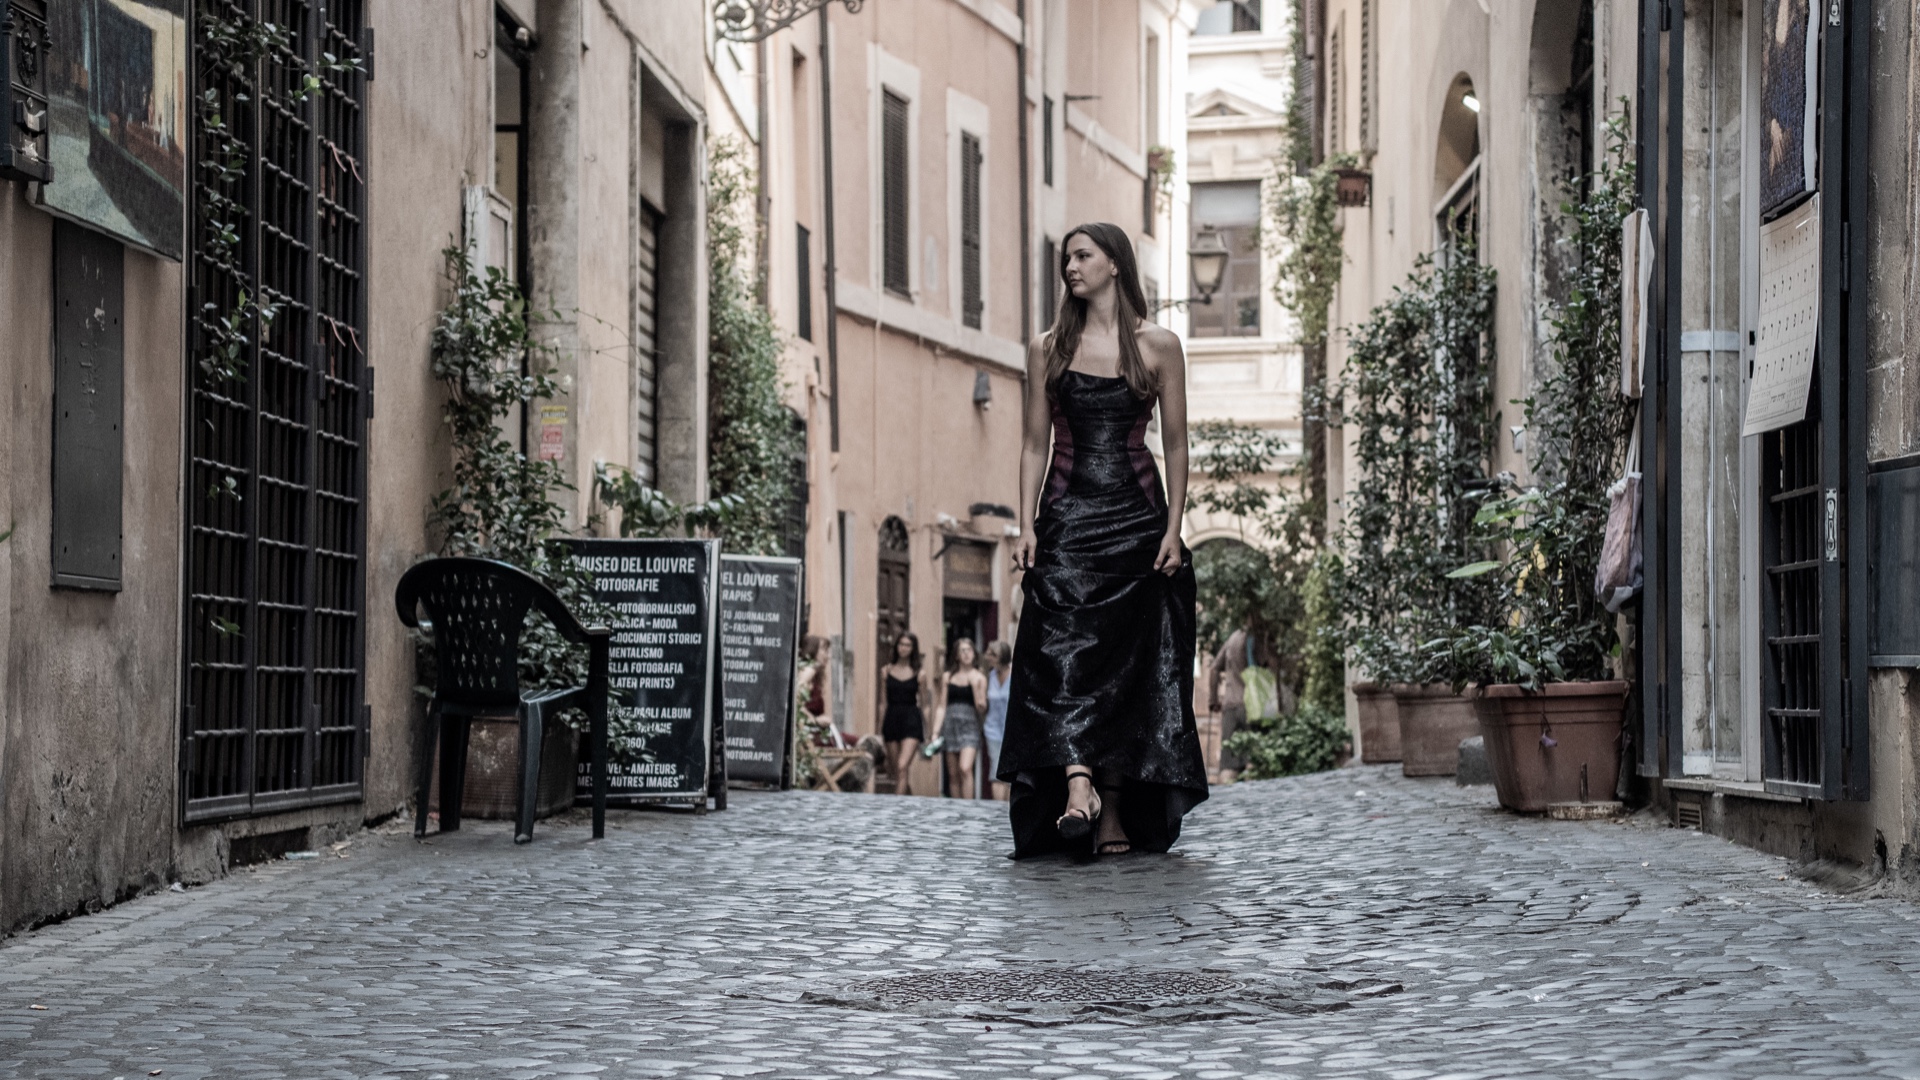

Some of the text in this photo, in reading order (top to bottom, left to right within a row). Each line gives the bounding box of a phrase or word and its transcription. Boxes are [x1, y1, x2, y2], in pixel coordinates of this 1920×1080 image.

[620, 557, 643, 572] DEL
[646, 557, 696, 573] LOUVRE
[595, 578, 660, 592] FOTOGRAFIE
[737, 573, 779, 588] LOUVRE
[616, 603, 696, 615] FOTOGIORNALISMO
[734, 611, 780, 622] JOURNALISM
[652, 618, 678, 629] MODA
[616, 632, 702, 645] DOCUMENTI STORICI
[753, 636, 782, 648] IMAGES
[630, 662, 684, 675] FOTOGRAFIA
[639, 677, 675, 690] PRINTS)
[660, 707, 692, 720] ALBUM
[734, 711, 766, 723] ALBUMS
[630, 763, 677, 775] AMATEURS
